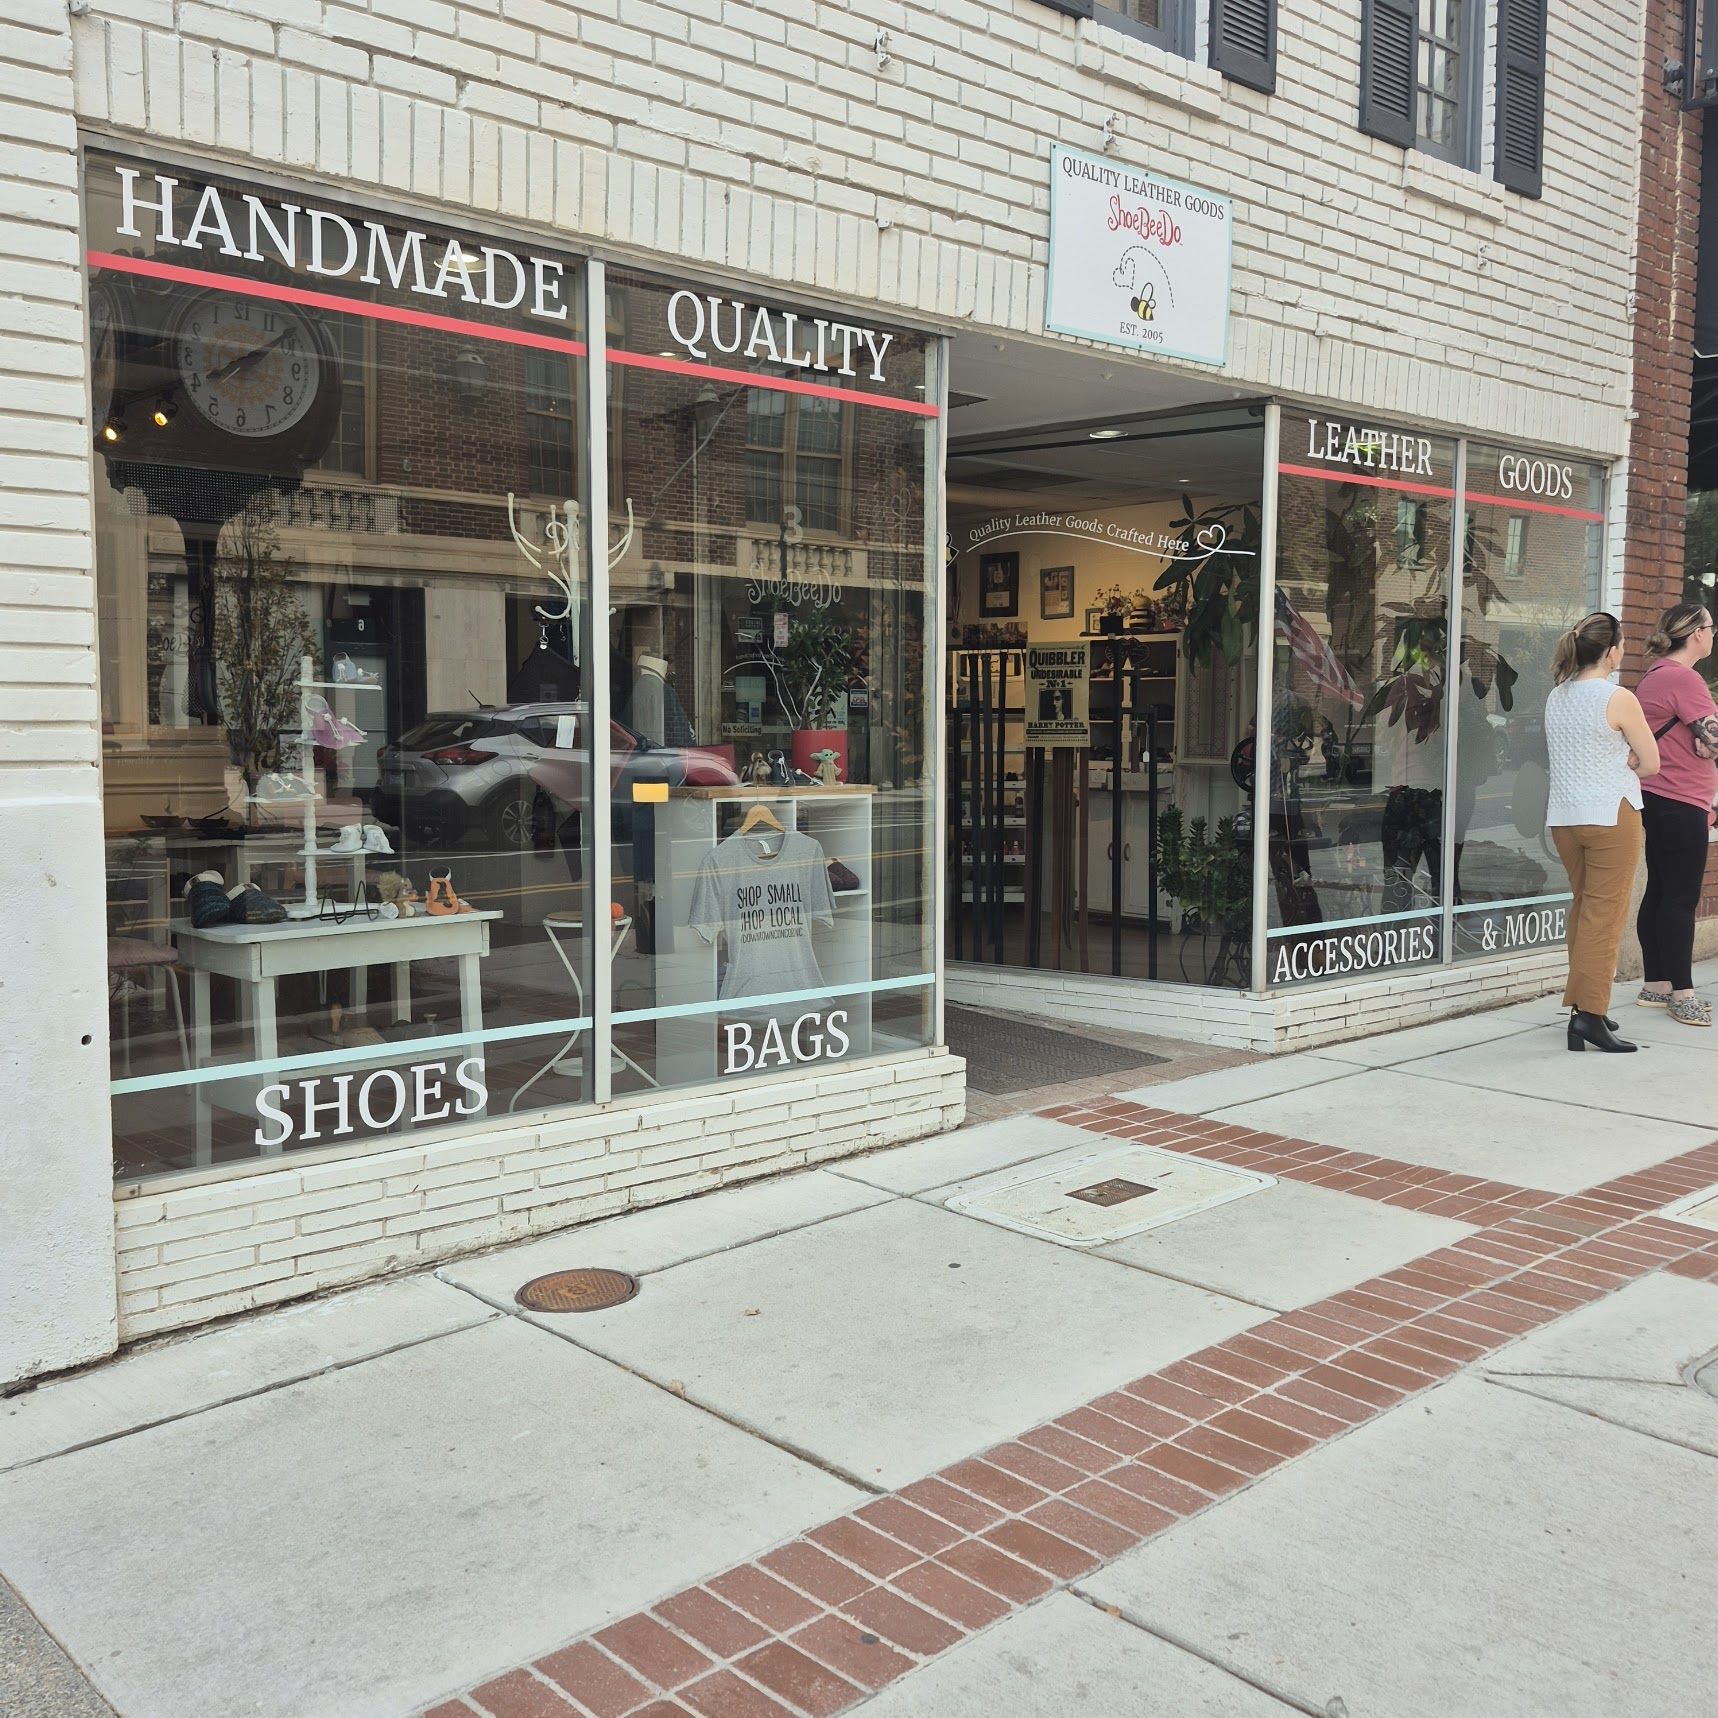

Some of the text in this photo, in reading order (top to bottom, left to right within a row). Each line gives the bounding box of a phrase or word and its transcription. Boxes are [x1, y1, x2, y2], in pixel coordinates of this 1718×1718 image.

[1062, 156, 1224, 220] QUALITY LEATHER GOODS
[115, 166, 568, 320] HANDMADE
[1107, 194, 1182, 246] ShoeBeeDo
[667, 290, 894, 382] QUALITY
[1120, 321, 1164, 344] EST. 2005
[1307, 418, 1433, 476] LEATHER
[1499, 454, 1573, 500] GOODS
[969, 511, 1190, 552] Quality Leather Goods Crafted Here
[1029, 650, 1086, 670] QUIBBLER
[737, 881, 803, 910] SHOP SMALL
[770, 906, 804, 928] LOCAL
[1272, 924, 1435, 984] ACCESSORIES
[1481, 907, 1567, 951] & MORE
[724, 1010, 850, 1075] BAGS
[254, 1057, 489, 1147] SHOES
